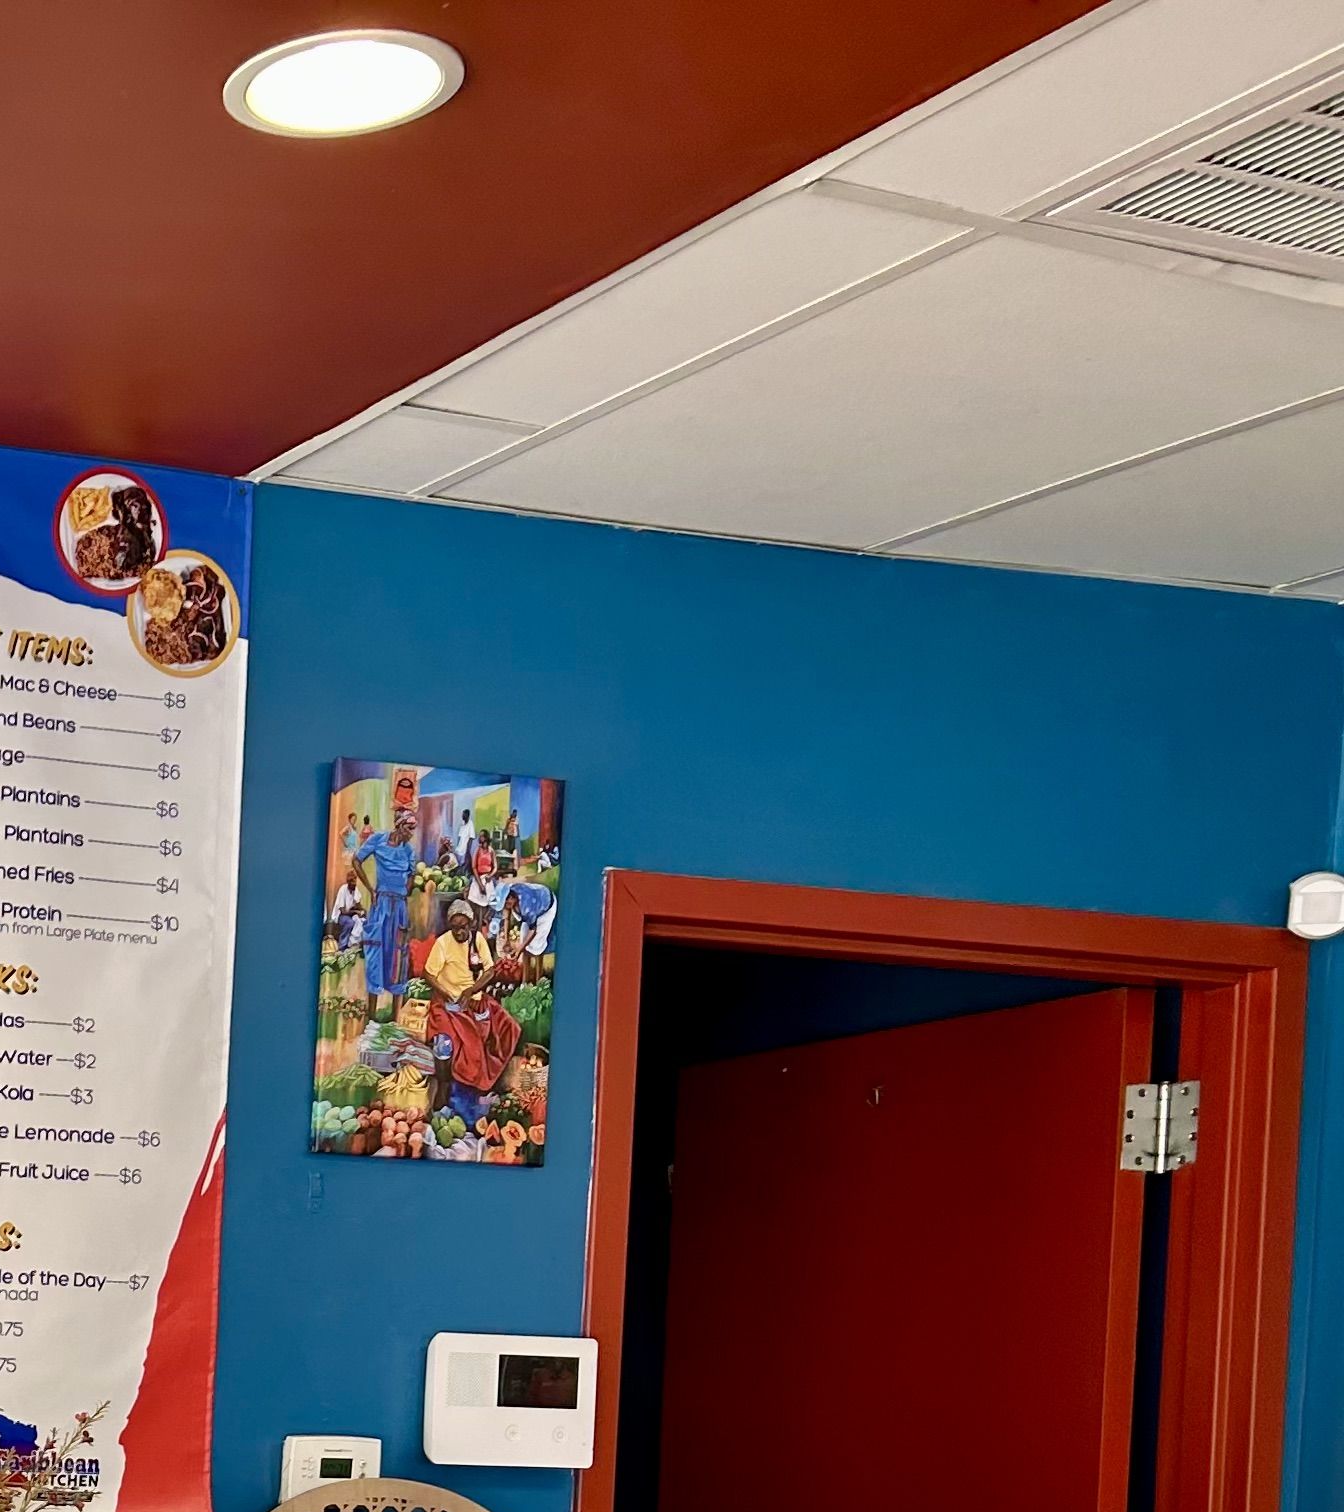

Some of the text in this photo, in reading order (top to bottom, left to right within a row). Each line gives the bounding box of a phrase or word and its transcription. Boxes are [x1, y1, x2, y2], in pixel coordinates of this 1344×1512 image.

[8, 629, 93, 666] ITEMS:
[0, 674, 35, 691] Mac
[39, 678, 49, 693] &
[53, 681, 117, 701] Cheese
[164, 692, 186, 708] $8
[23, 713, 76, 733] Beans
[160, 727, 181, 744] $7
[158, 763, 181, 780] $6
[1, 786, 81, 808] Plantains
[156, 801, 178, 818] $6
[5, 825, 84, 847] Plantains
[160, 839, 182, 857] $6
[35, 866, 74, 885] Fries
[156, 876, 179, 894] $4
[2, 903, 62, 922] Protein
[150, 914, 179, 932] $10
[12, 922, 43, 936] from
[46, 925, 81, 941] Large
[84, 928, 113, 942] Plate
[118, 933, 157, 945] menu
[72, 1017, 95, 1034] $2
[74, 1052, 96, 1070] $2
[70, 1087, 94, 1105] $3
[15, 1123, 115, 1144] Lemonade
[137, 1130, 161, 1148] $6
[42, 1164, 89, 1181] Juice
[119, 1167, 142, 1185] $6
[18, 1270, 36, 1286] of
[40, 1271, 69, 1287] the
[73, 1273, 107, 1292] Day
[128, 1274, 150, 1291] $7
